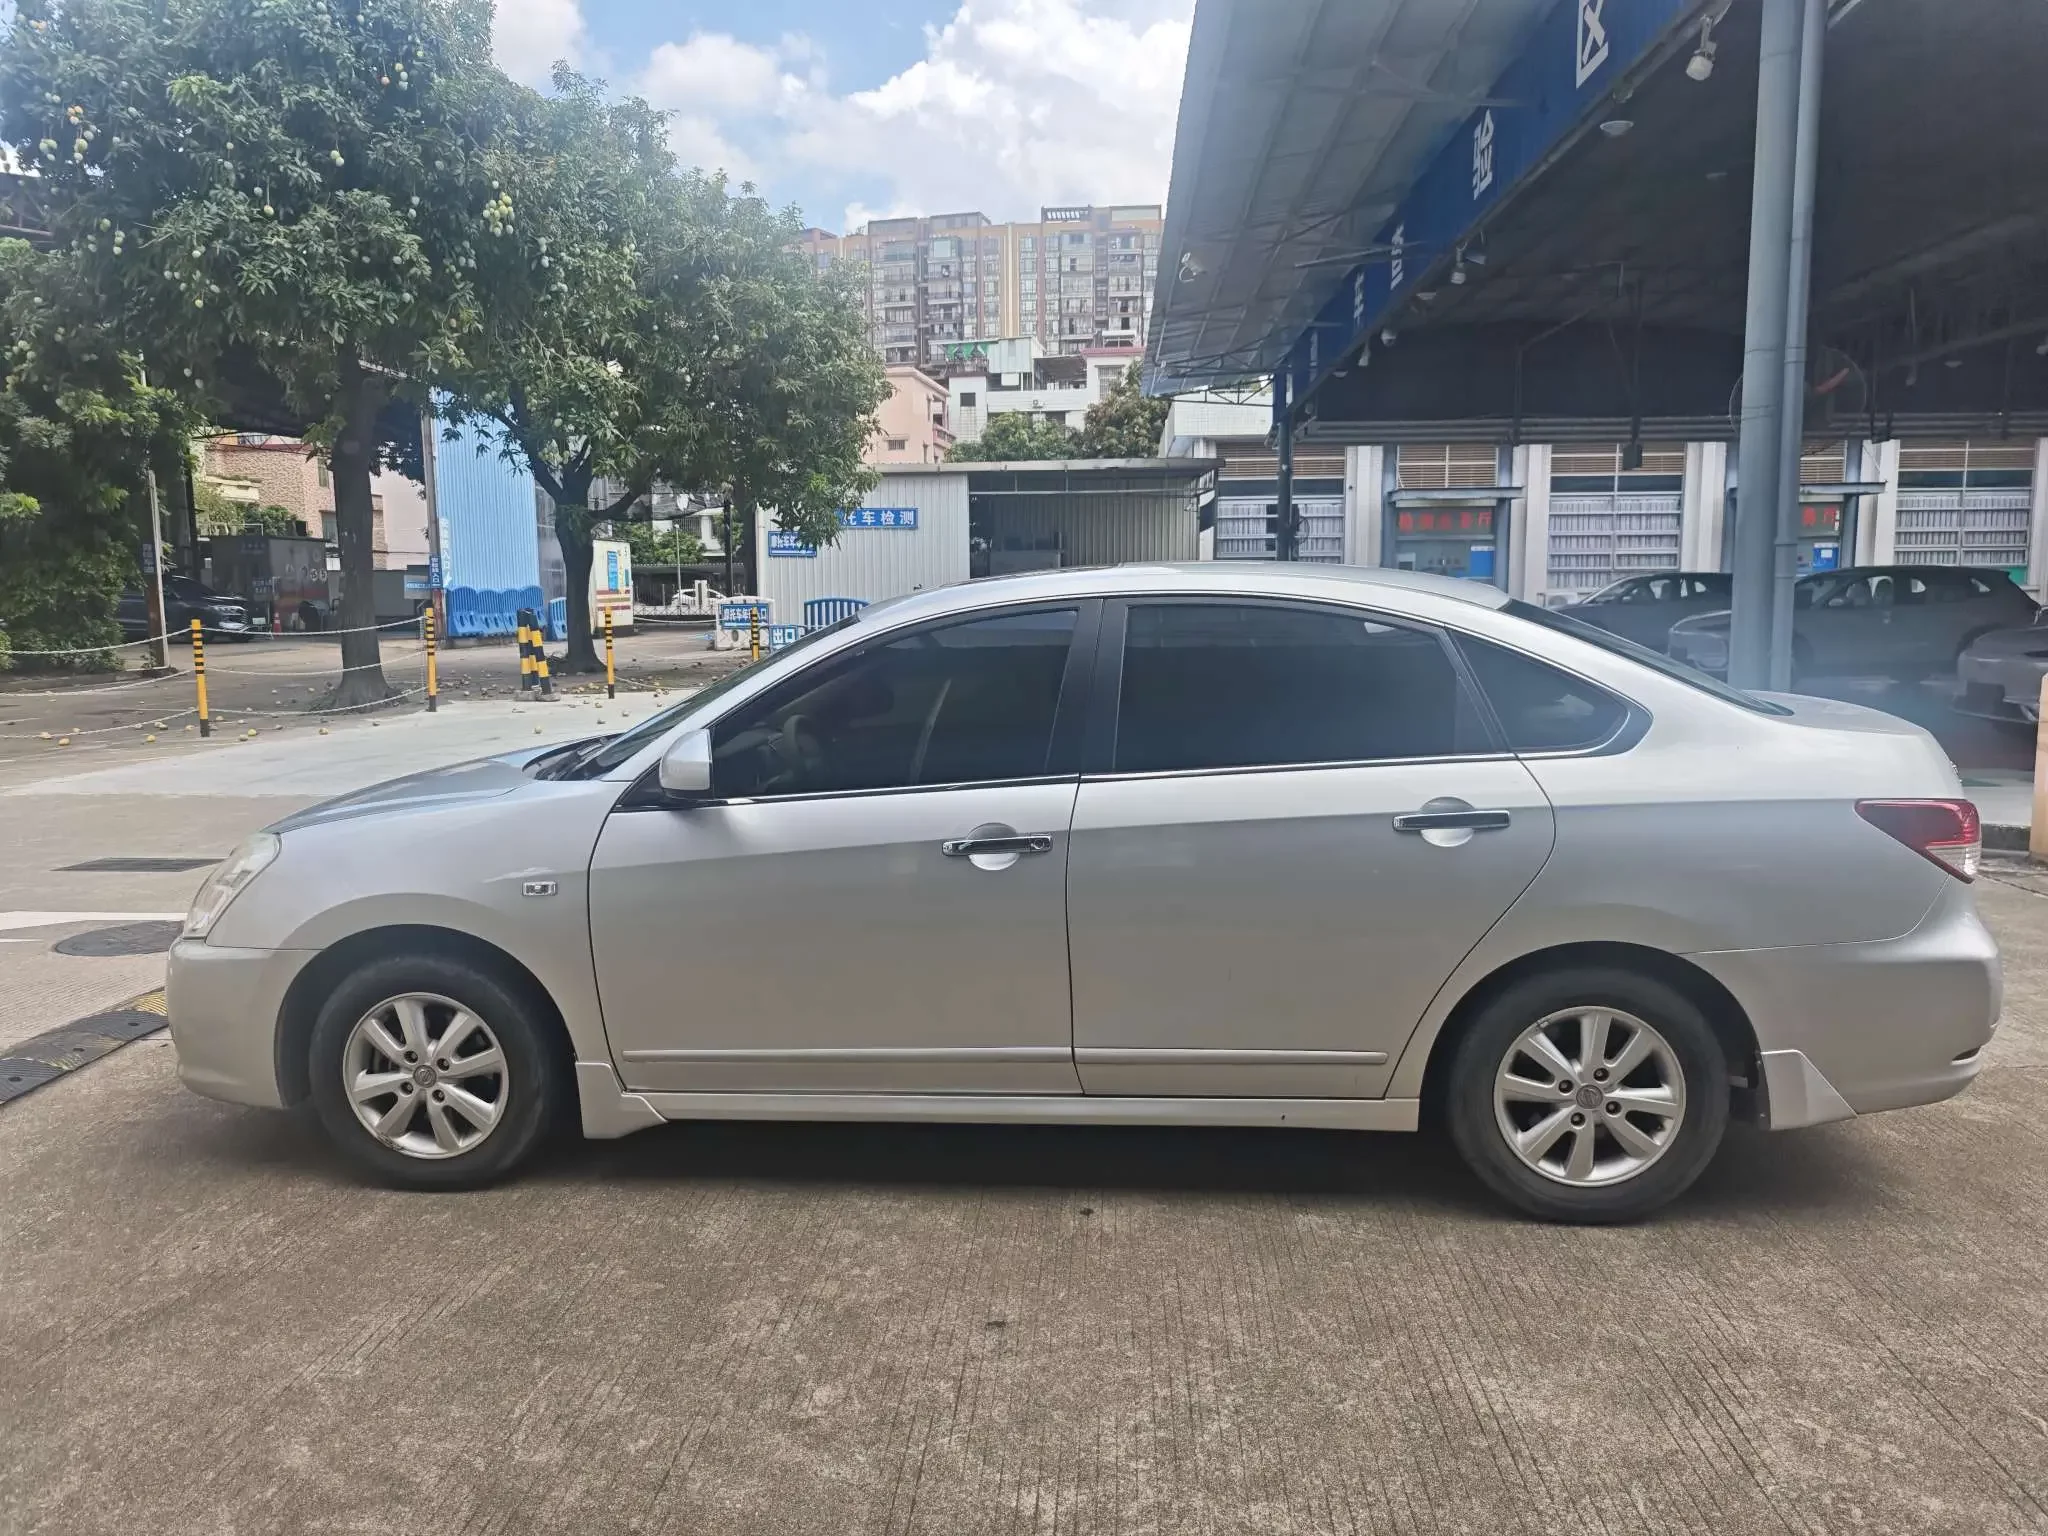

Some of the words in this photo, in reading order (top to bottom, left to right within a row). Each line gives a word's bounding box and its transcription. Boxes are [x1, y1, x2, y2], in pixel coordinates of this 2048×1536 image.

[843, 510, 914, 526] 托车检测
[773, 628, 795, 644] 出口
